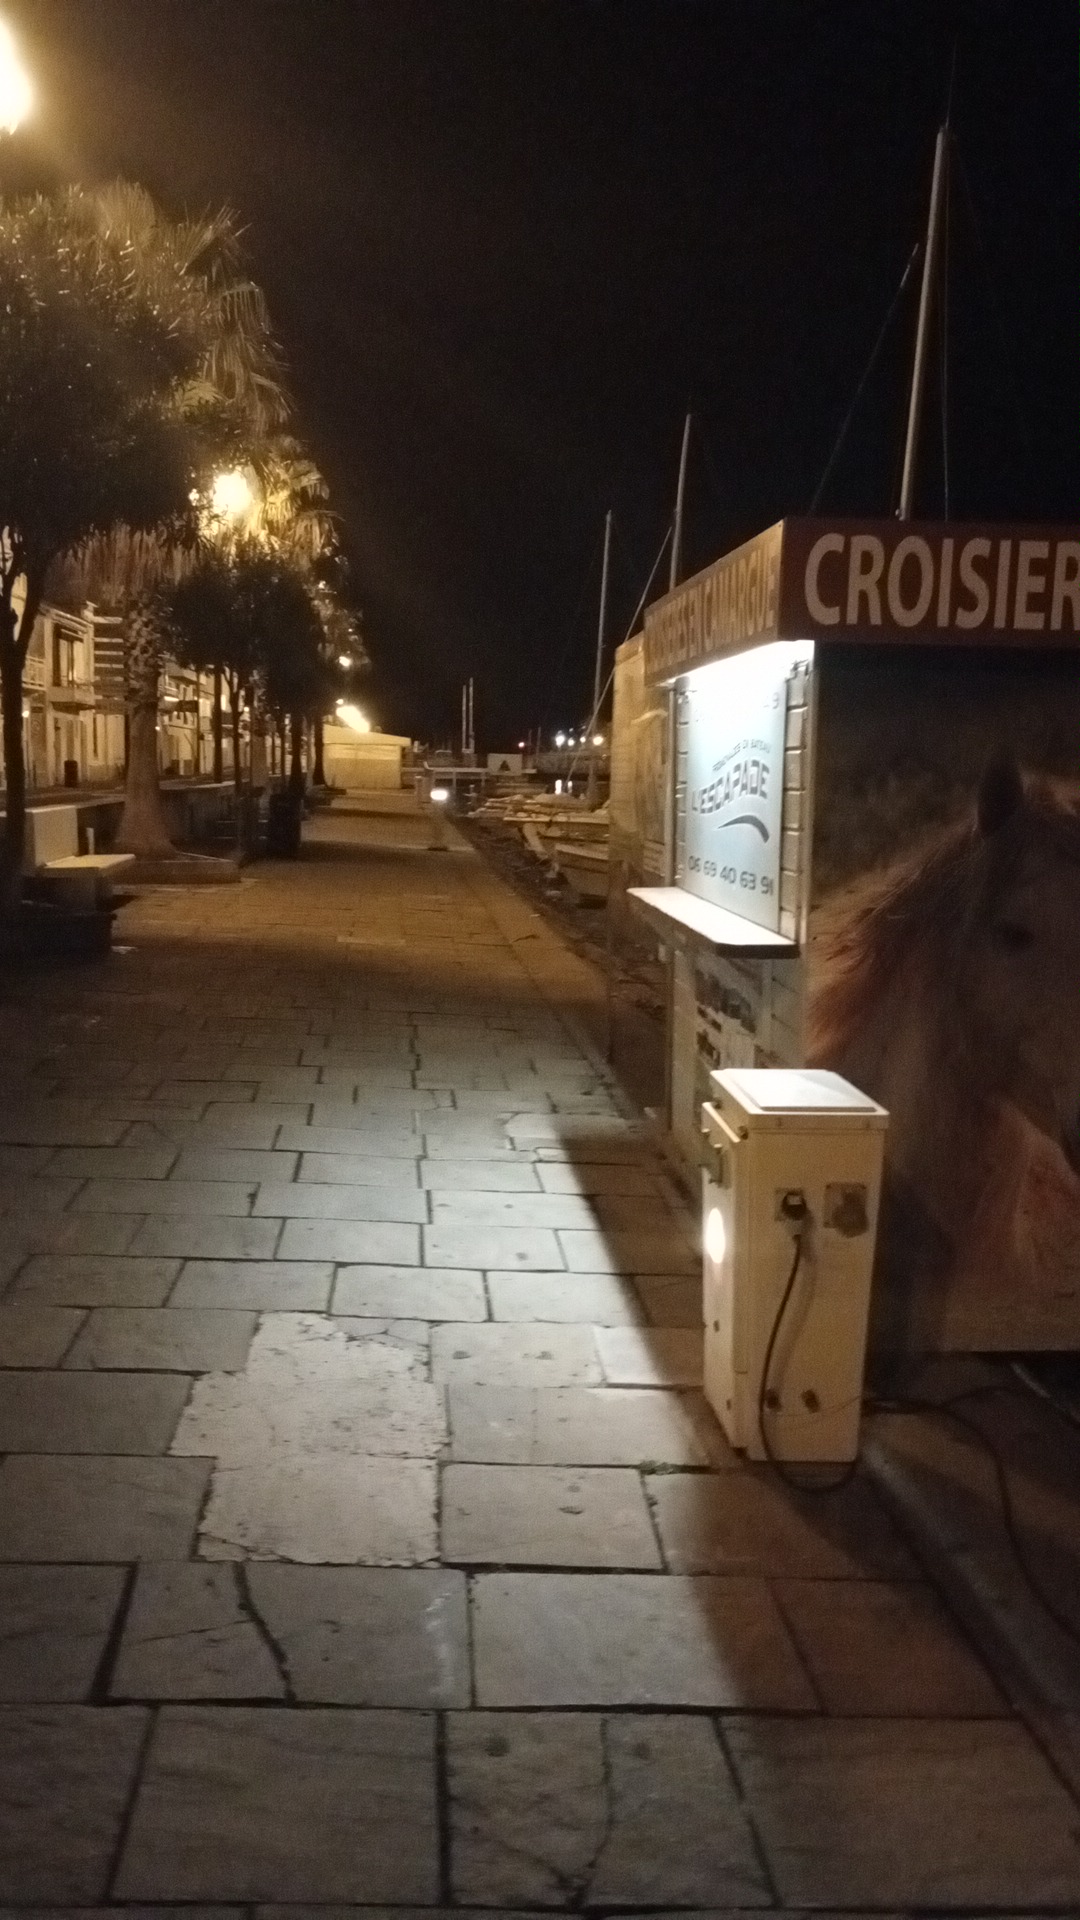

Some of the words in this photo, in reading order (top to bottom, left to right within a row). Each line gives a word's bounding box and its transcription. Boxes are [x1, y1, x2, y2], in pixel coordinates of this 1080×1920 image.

[703, 538, 777, 653] CAMARGUE
[804, 532, 1080, 631] CROISIER
[688, 855, 701, 872] 06
[719, 865, 737, 884] 40
[740, 871, 757, 890] 63
[760, 876, 774, 896] 91
